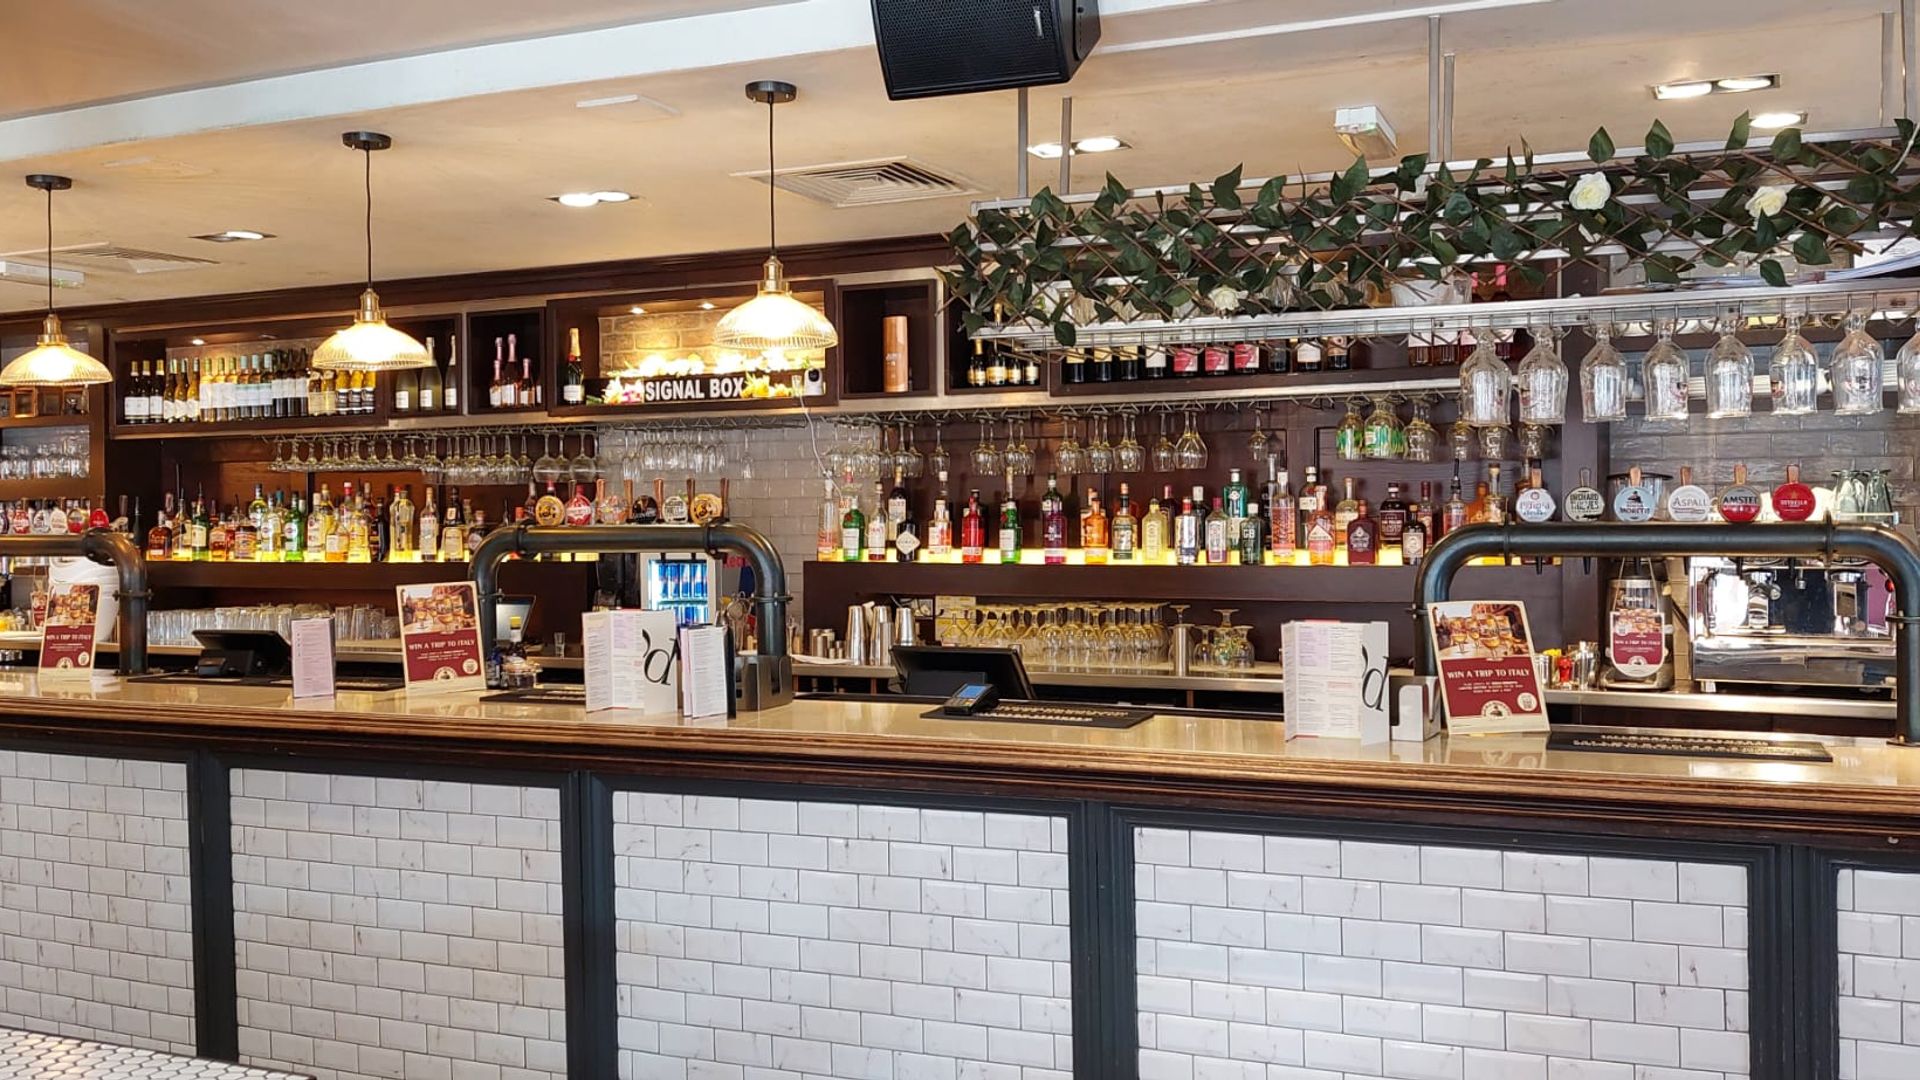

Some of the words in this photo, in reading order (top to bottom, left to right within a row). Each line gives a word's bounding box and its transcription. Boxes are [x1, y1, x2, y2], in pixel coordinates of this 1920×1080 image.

[645, 379, 704, 401] SIGNAL
[709, 377, 744, 398] BOX
[408, 643, 422, 651] WIN
[431, 641, 446, 649] TRIP
[447, 640, 456, 648] TO
[457, 639, 475, 647] ITALY
[1447, 671, 1464, 679] WIN
[1466, 670, 1473, 678] A
[1473, 669, 1493, 678] TRIP
[1494, 669, 1506, 677] TO
[1508, 668, 1530, 676] ITALY
